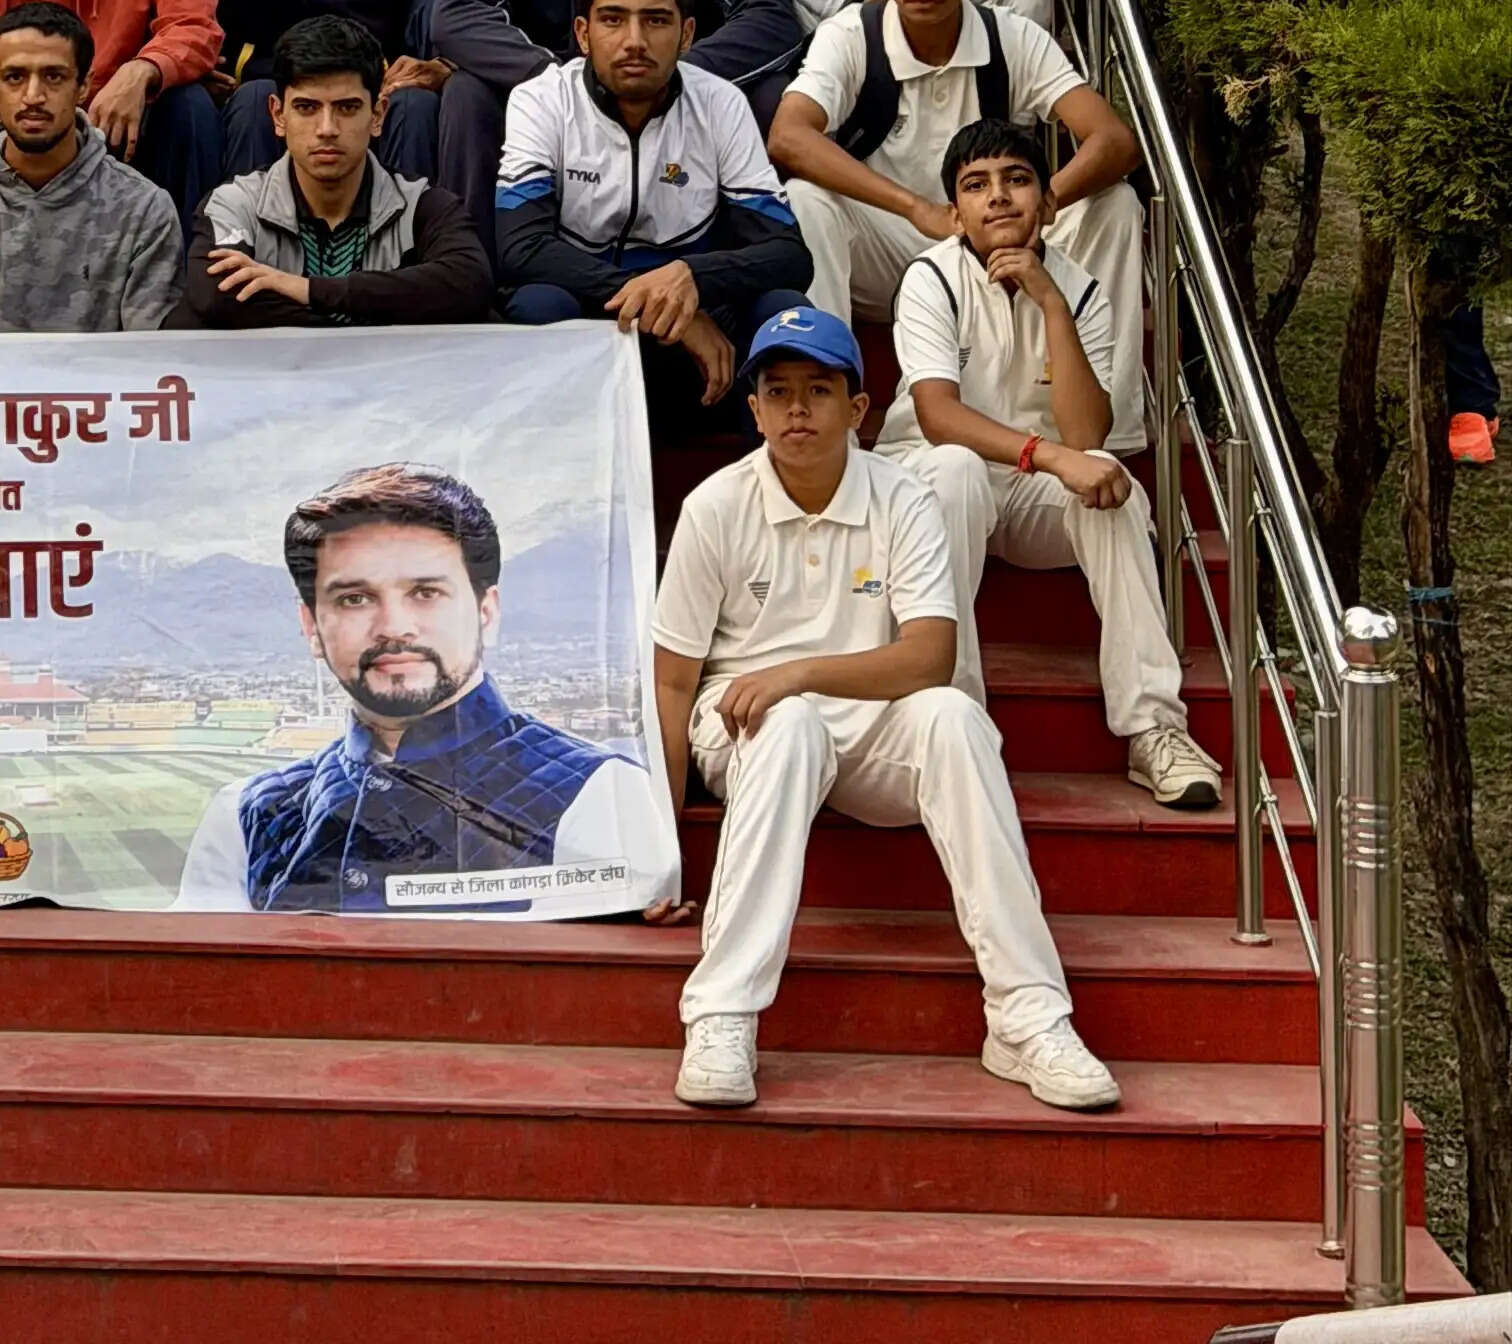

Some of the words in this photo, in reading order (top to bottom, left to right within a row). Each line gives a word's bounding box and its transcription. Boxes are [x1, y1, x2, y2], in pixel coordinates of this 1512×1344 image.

[566, 169, 600, 185] TYKA
[120, 375, 196, 442] जी
[451, 877, 465, 895] से
[468, 875, 505, 894] जिला
[599, 864, 626, 882] संघ
